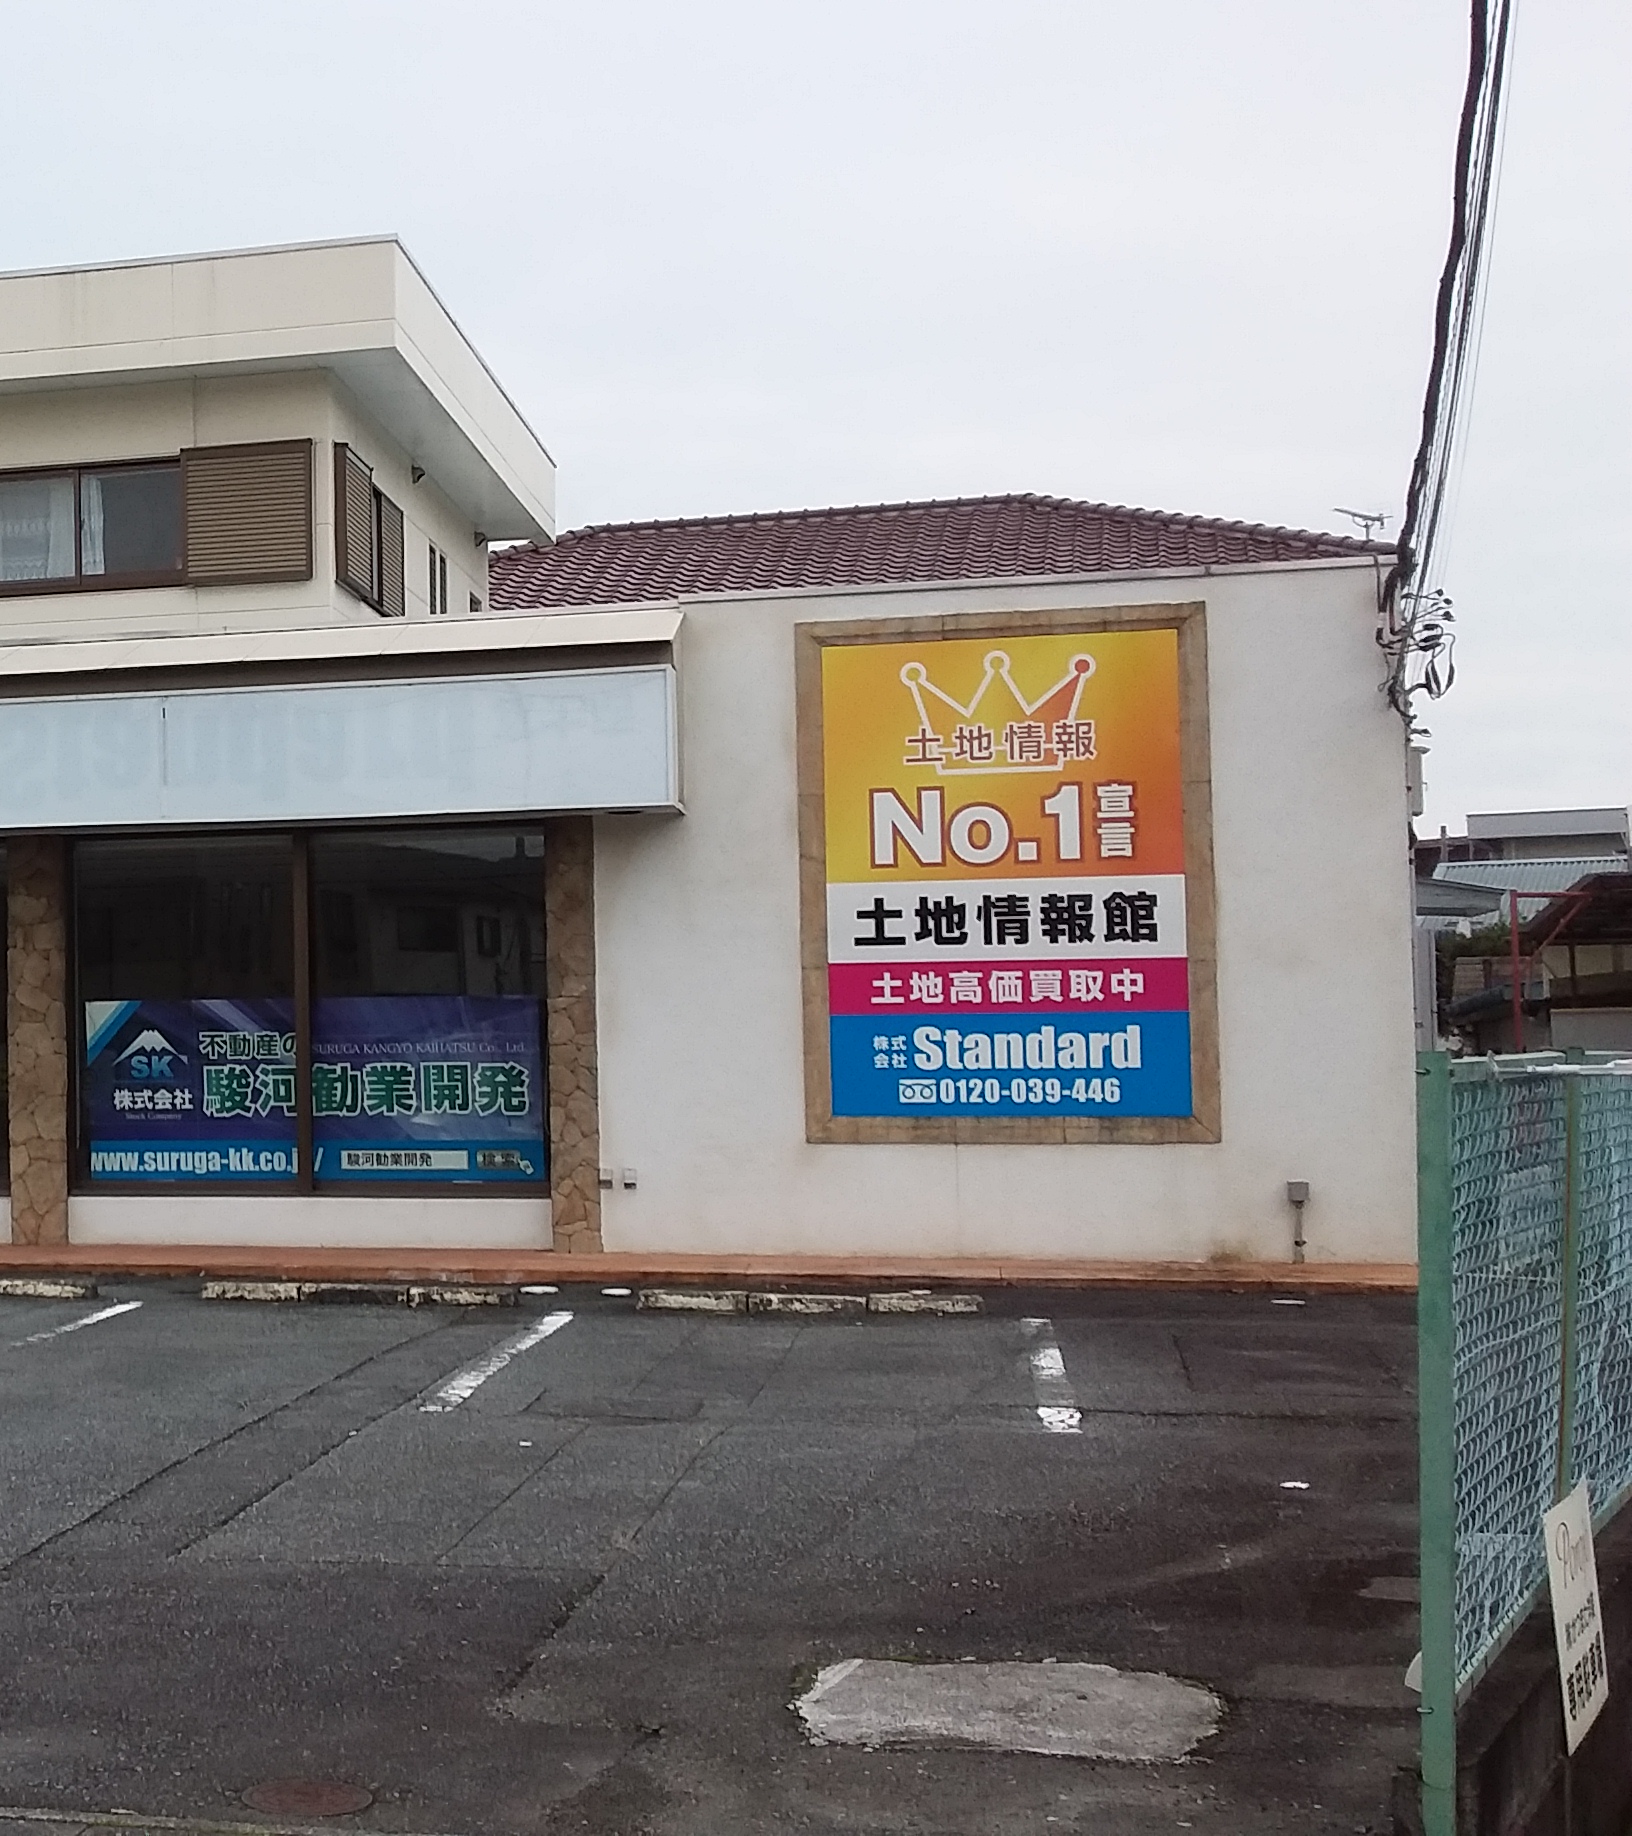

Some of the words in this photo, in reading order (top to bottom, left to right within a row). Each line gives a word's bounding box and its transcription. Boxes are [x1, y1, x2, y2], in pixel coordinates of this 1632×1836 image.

[903, 720, 1097, 765] 土地情報
[870, 782, 1083, 868] No.1
[1095, 781, 1137, 858] 宣言
[853, 890, 1159, 946] 土地情報館
[870, 968, 1145, 1004] 土地高価買取中
[130, 1054, 174, 1079] SK
[363, 1042, 412, 1054] KANGYO
[913, 1025, 1142, 1071] Standard
[113, 1087, 194, 1111] 株式会社
[202, 1062, 529, 1118] 駿河勧業開発
[939, 1077, 1121, 1104] 0120-039-446
[90, 1147, 324, 1174] www.suruga-kk.co.j/
